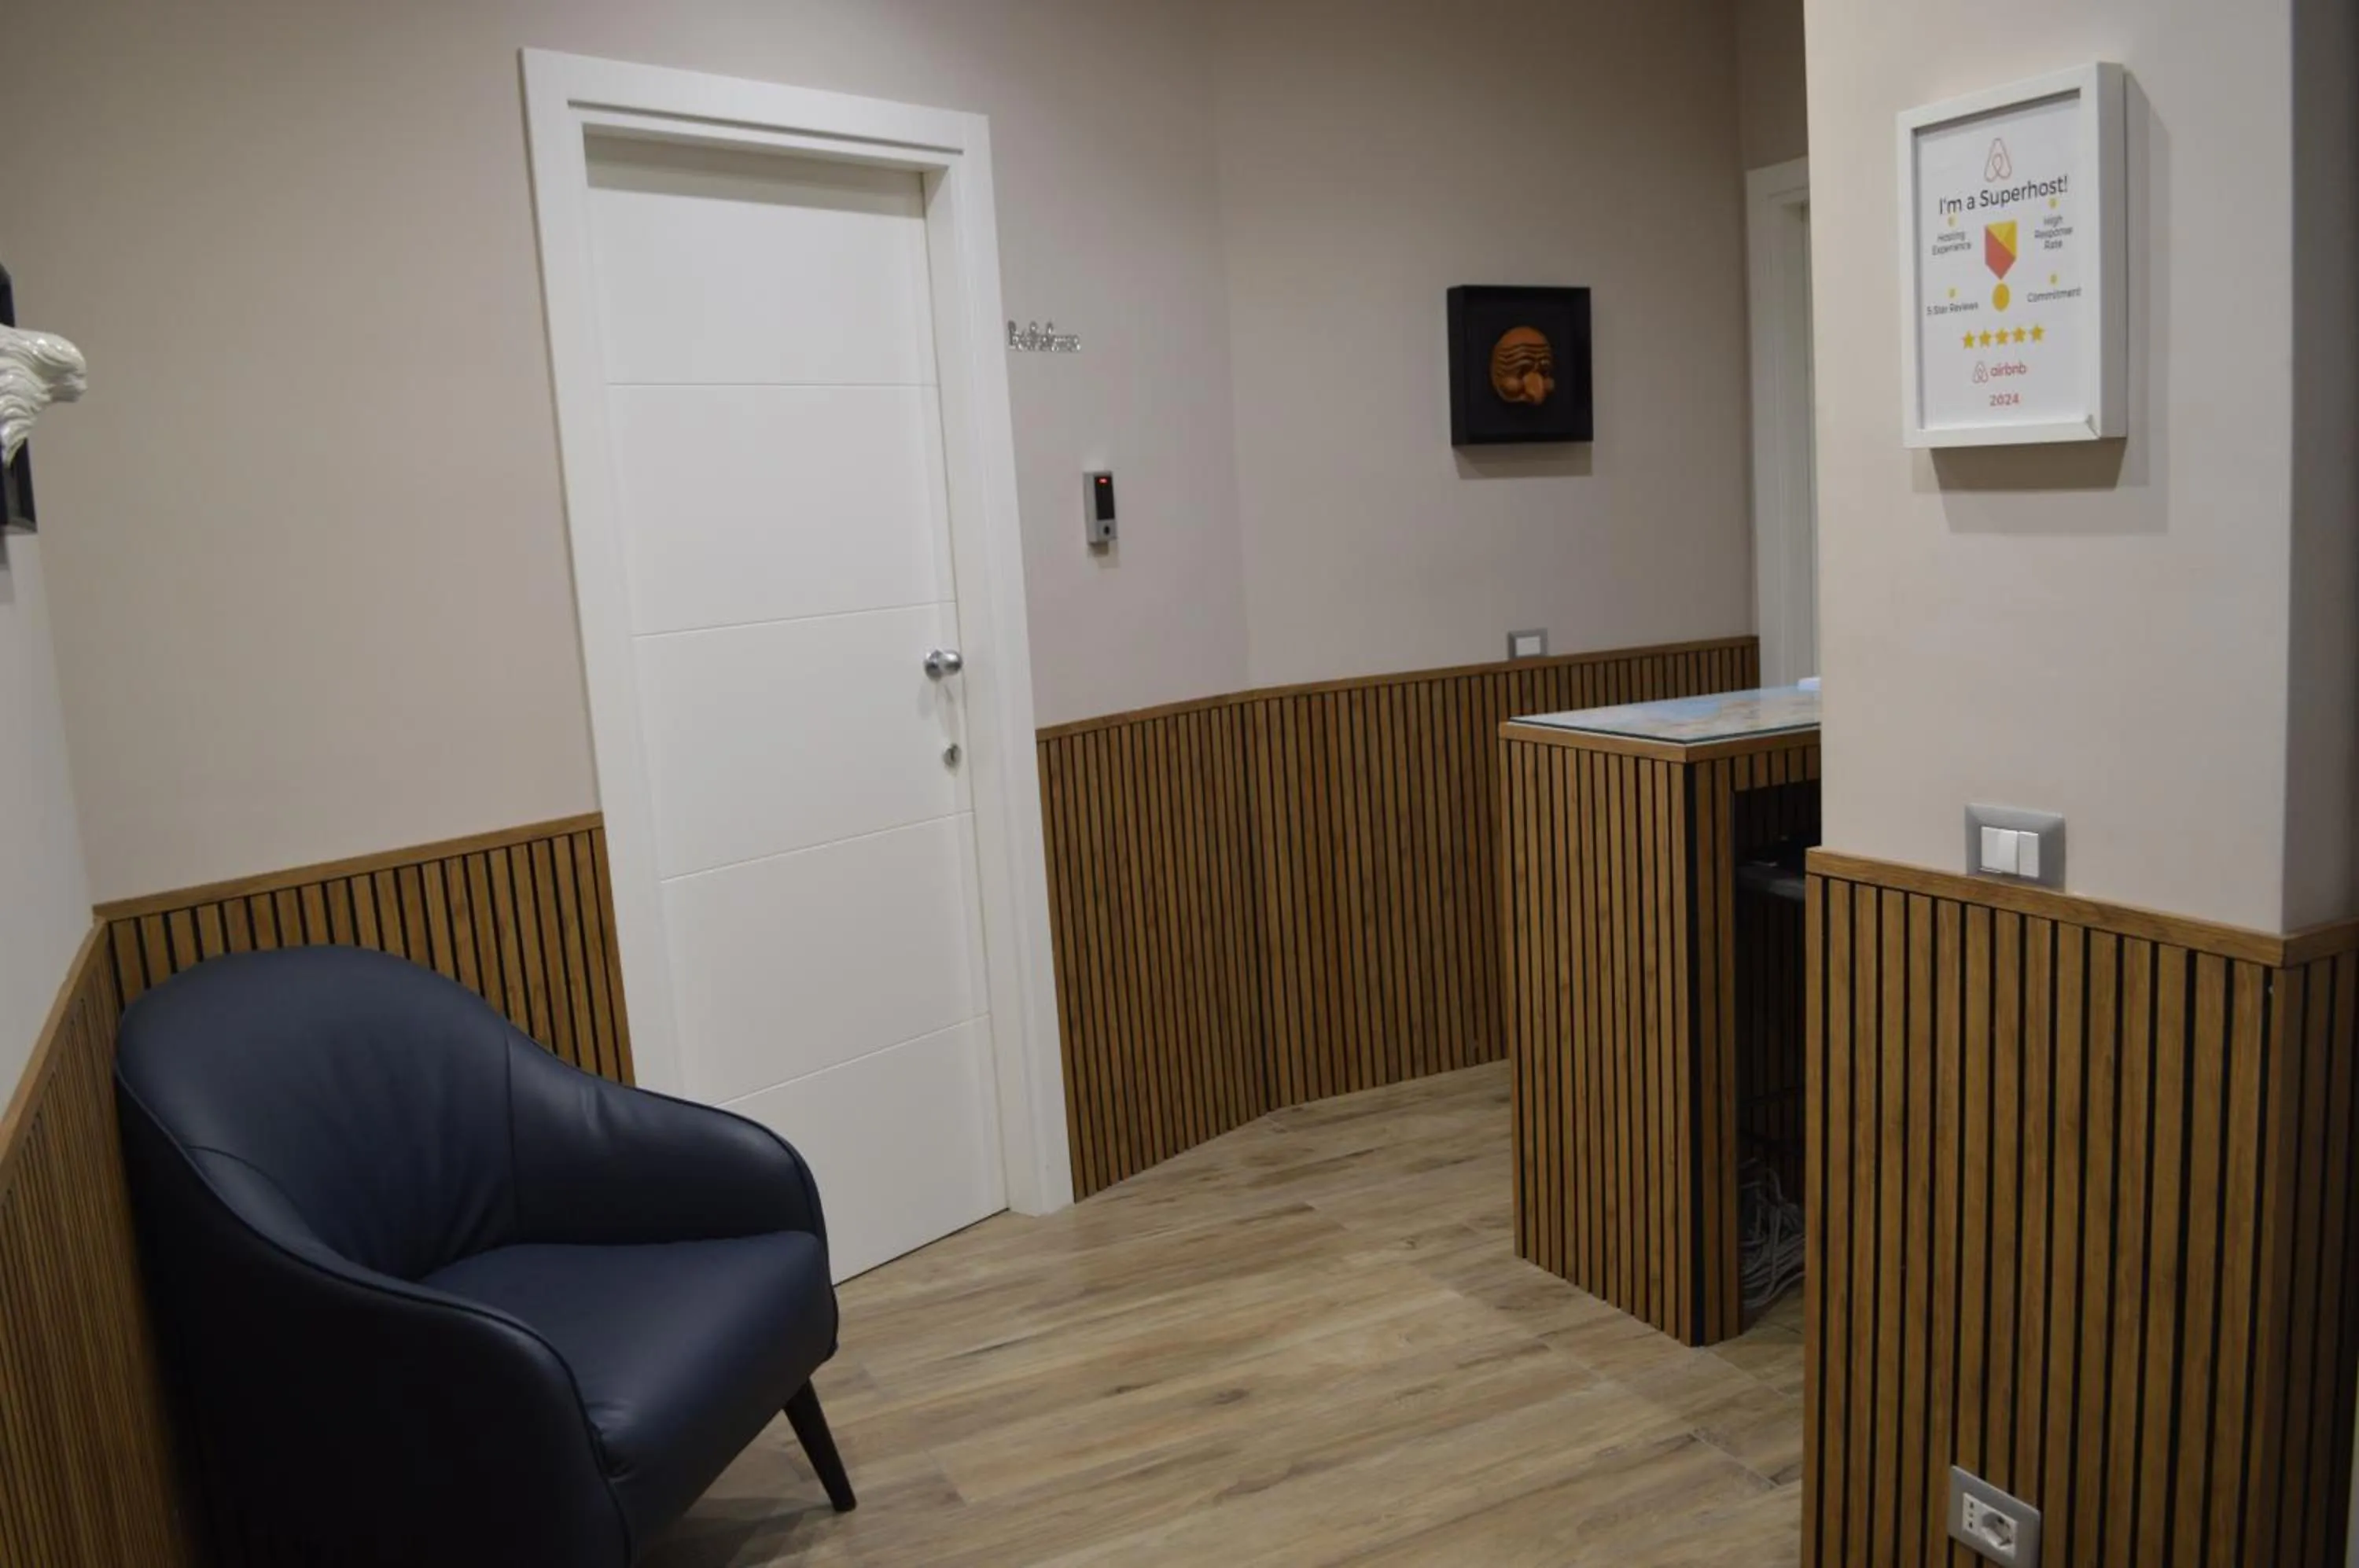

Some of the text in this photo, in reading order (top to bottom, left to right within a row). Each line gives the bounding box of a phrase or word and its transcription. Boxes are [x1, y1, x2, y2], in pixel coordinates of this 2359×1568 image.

[1939, 175, 2069, 215] I'm a Superhost!
[1931, 241, 1972, 256] Experience
[2044, 239, 2063, 250] Rate
[2026, 286, 2082, 303] Commitment
[1989, 361, 2026, 377] airbnb
[1989, 392, 2020, 407] 2024
